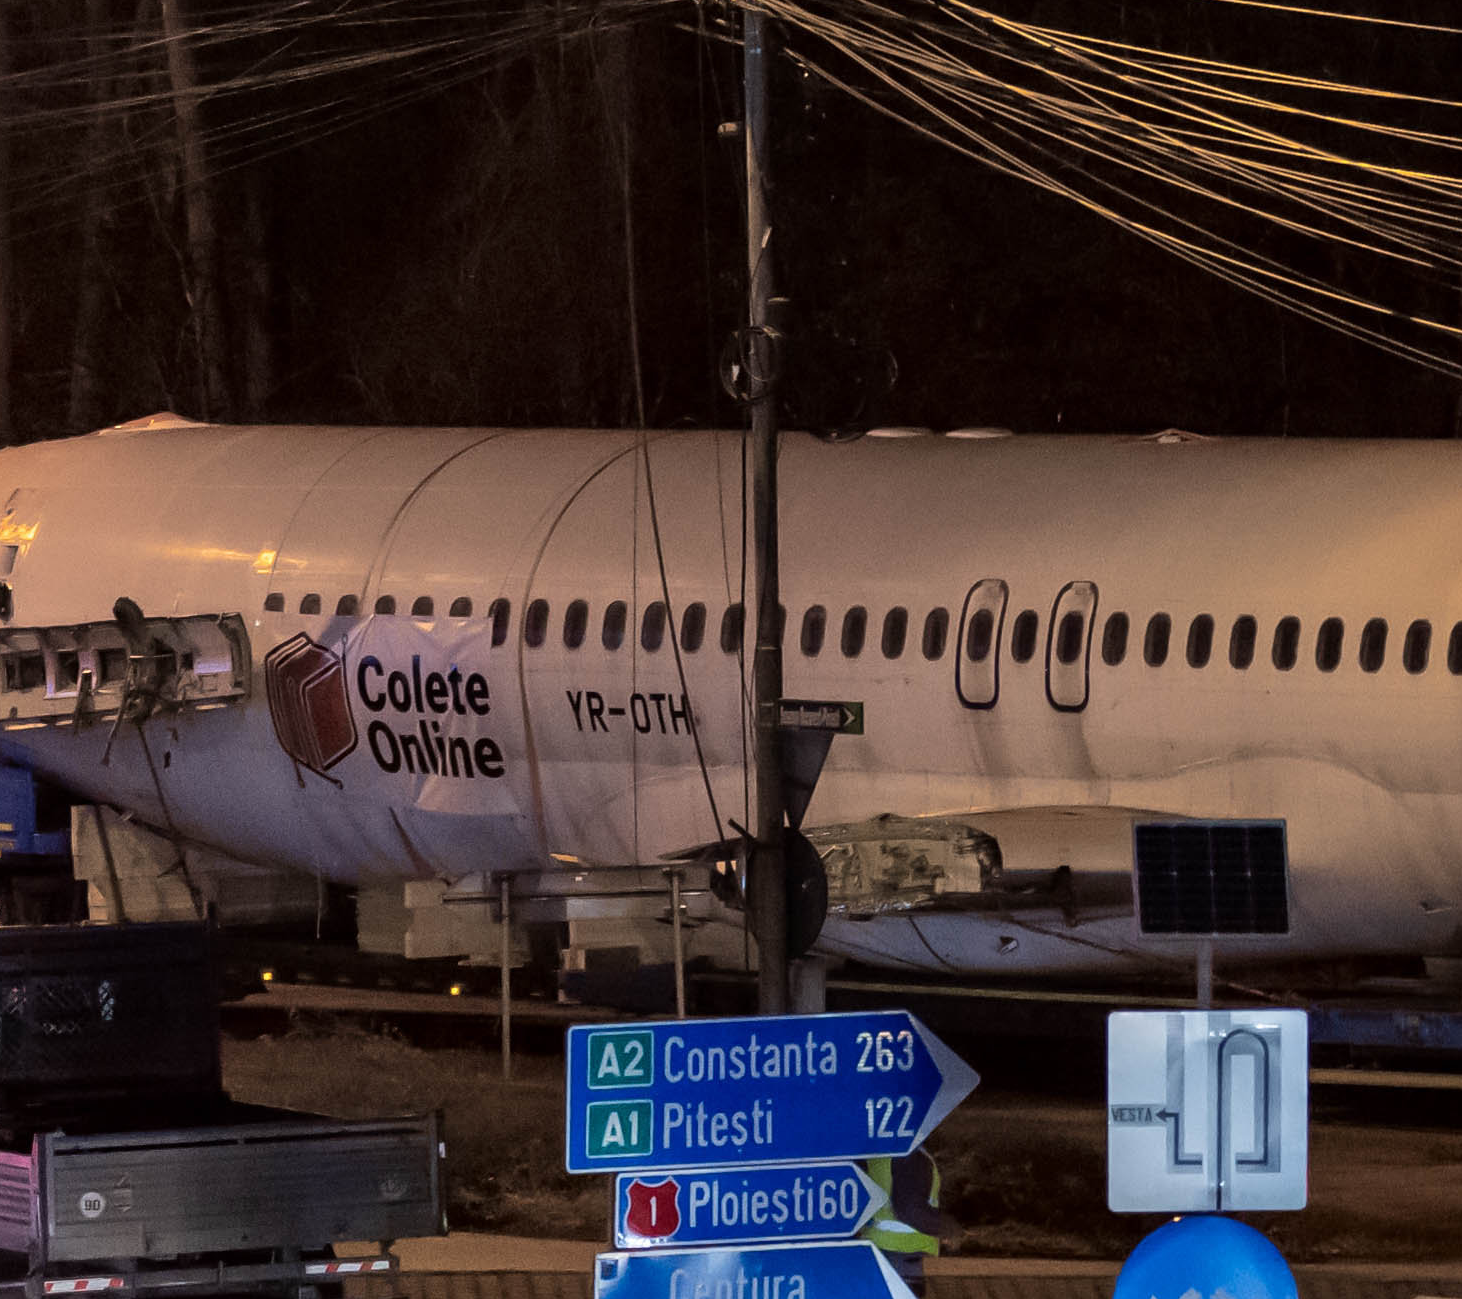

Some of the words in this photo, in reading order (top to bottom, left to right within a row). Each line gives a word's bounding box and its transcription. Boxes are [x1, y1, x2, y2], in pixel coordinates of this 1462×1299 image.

[357, 654, 491, 717] Colete
[565, 689, 691, 735] YR-OTH
[367, 720, 506, 779] Online
[598, 1040, 644, 1078] A2
[855, 1030, 915, 1073] 263
[601, 1111, 638, 1147] A1
[865, 1096, 915, 1139] 122
[1111, 1107, 1153, 1123] VESTA
[84, 1199, 101, 1211] 90
[650, 1196, 658, 1226] 1
[820, 1177, 859, 1220] 60
